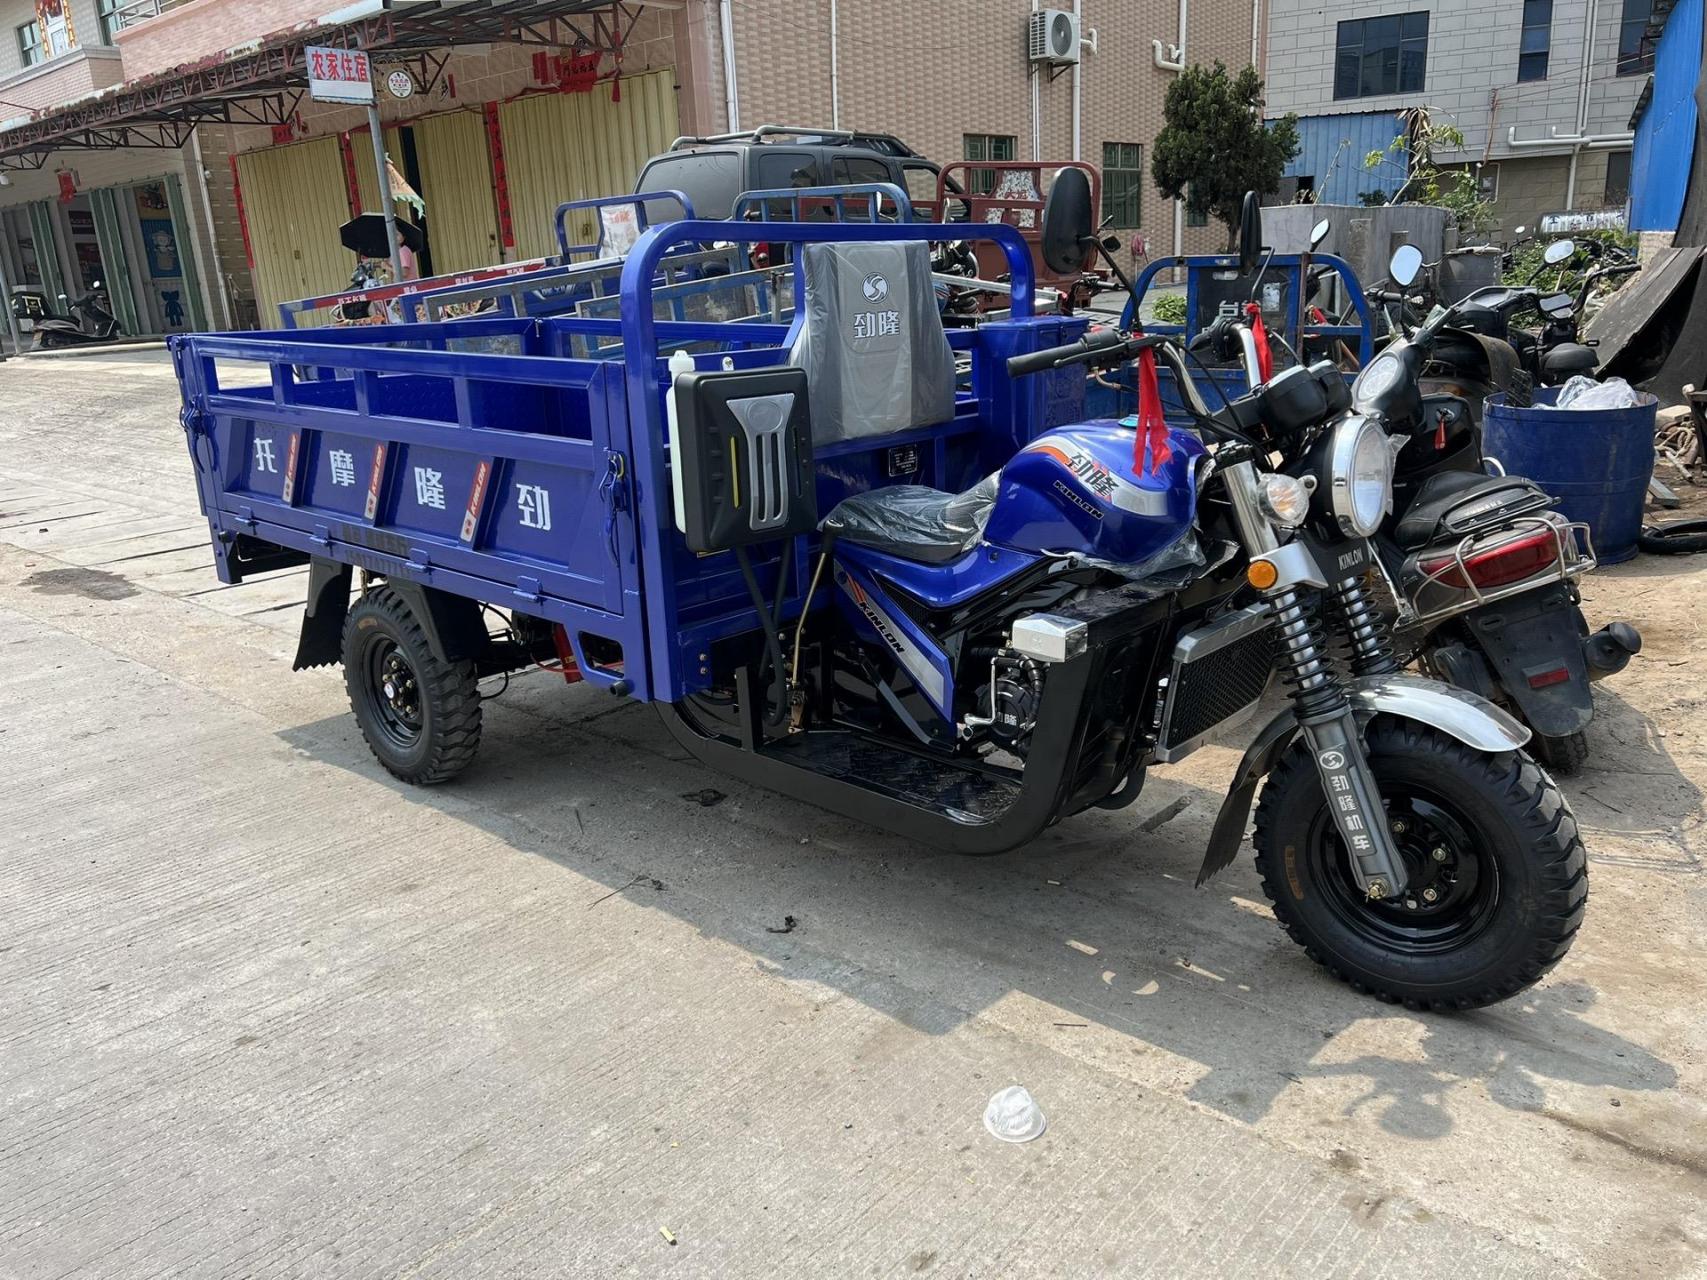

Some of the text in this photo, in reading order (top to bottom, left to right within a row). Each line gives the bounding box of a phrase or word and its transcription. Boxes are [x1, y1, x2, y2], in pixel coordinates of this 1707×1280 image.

[311, 50, 369, 83] 农家住宿
[854, 310, 900, 339] 劲隆
[470, 463, 487, 515] KINLON
[1065, 452, 1119, 497] 劲隆
[1053, 480, 1104, 519] KINLON
[1338, 547, 1364, 571] KINLON
[860, 601, 905, 653] KINLON
[1330, 775, 1370, 850] 劲隆机车
